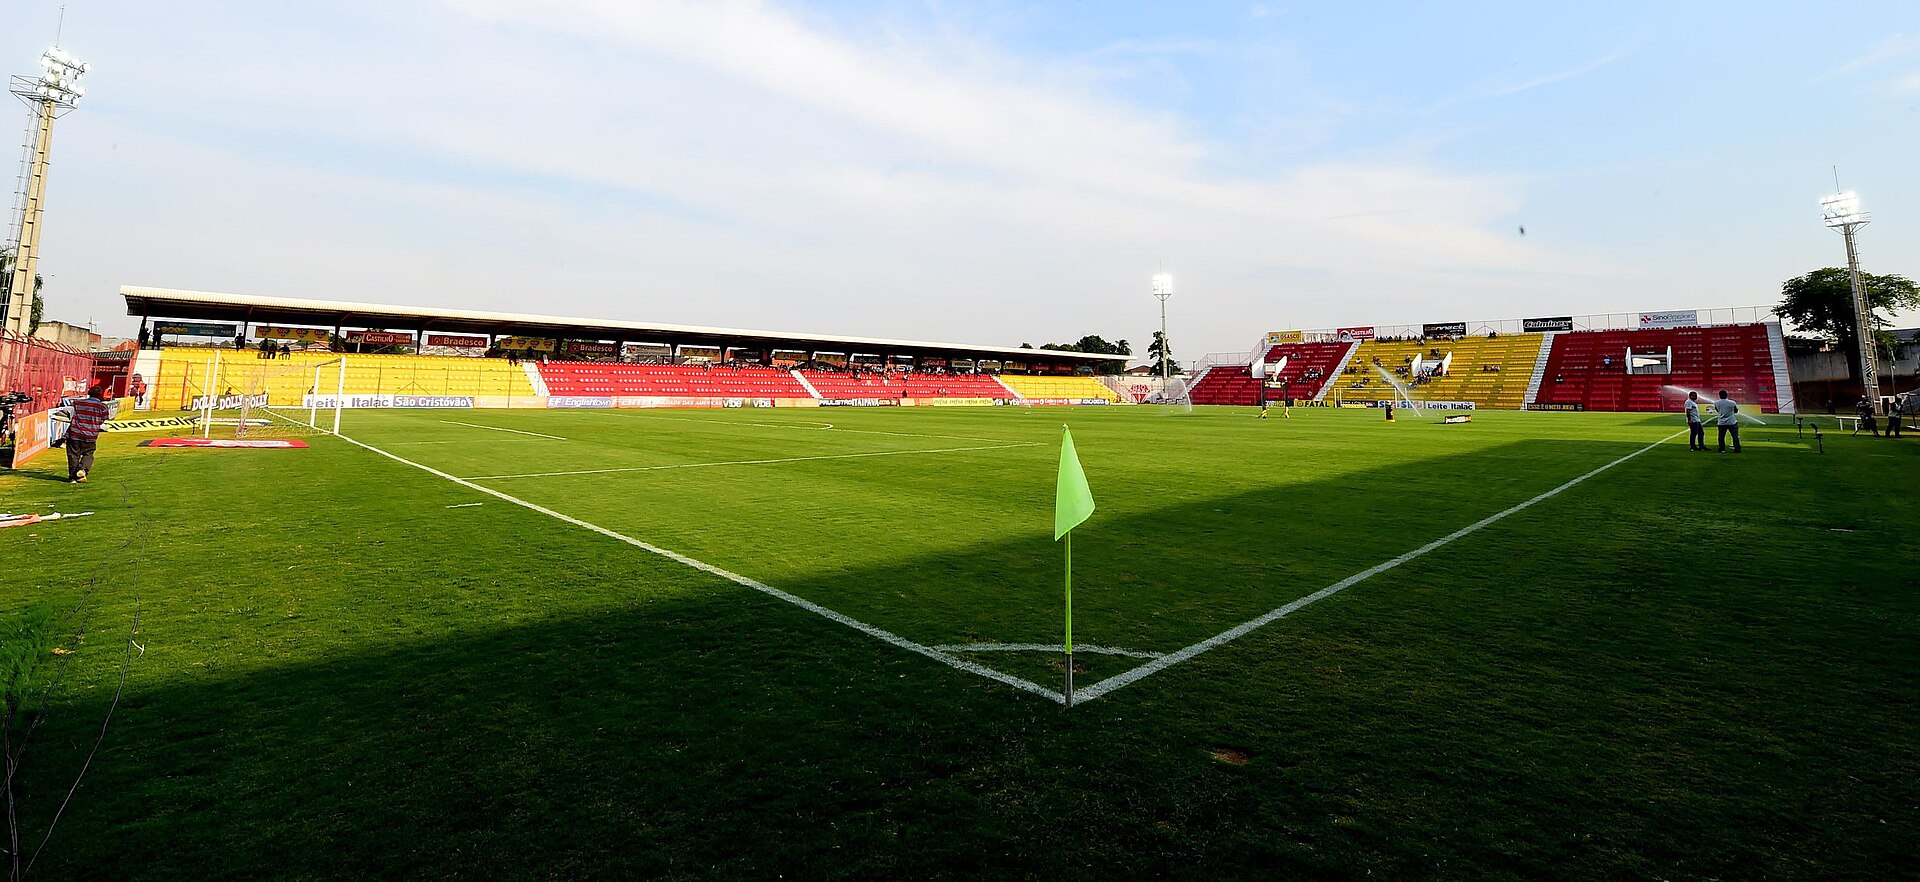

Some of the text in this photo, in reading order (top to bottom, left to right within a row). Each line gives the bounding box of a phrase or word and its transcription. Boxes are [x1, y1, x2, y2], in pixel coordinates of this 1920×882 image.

[443, 338, 484, 346] Bradesco
[580, 344, 613, 352] Bradesco
[192, 395, 219, 411] DOLY
[219, 395, 243, 410] DOLLY
[306, 397, 389, 408] Leite Italac
[395, 396, 467, 407] São Cristóvão
[548, 397, 611, 408] EF Englishtown
[1450, 402, 1473, 410] Italac
